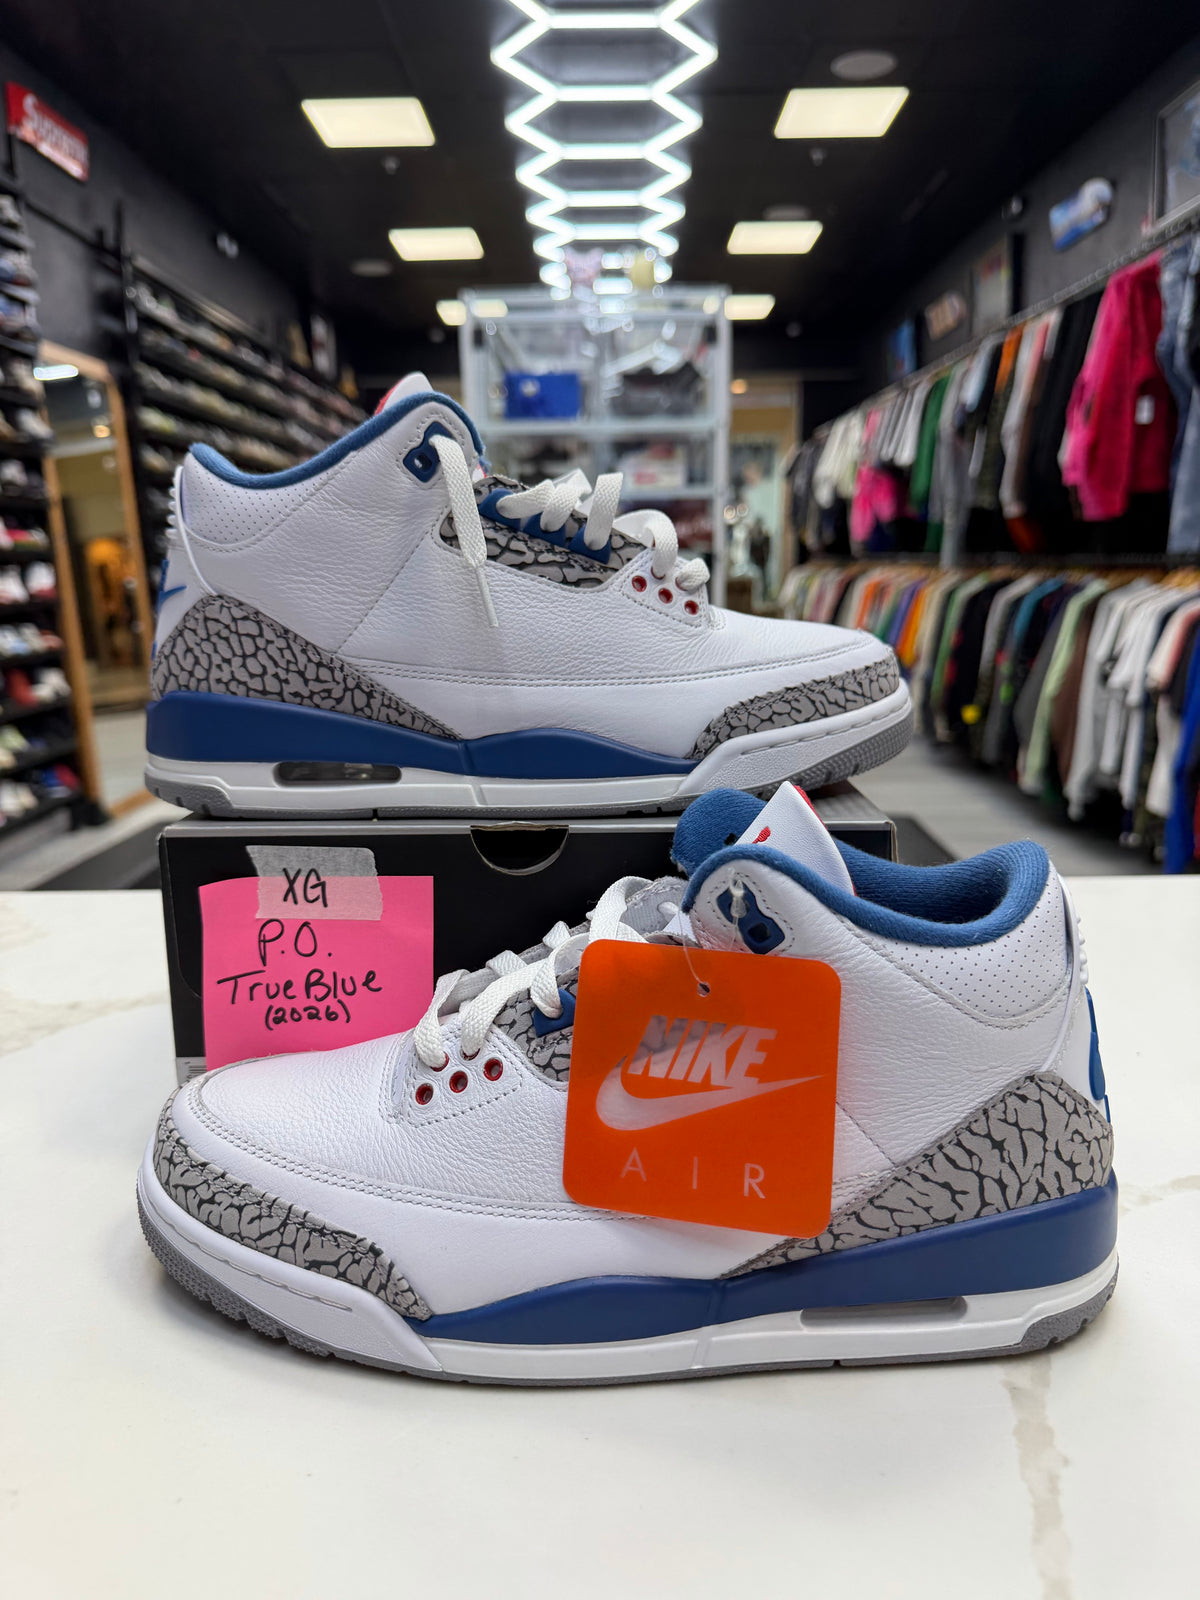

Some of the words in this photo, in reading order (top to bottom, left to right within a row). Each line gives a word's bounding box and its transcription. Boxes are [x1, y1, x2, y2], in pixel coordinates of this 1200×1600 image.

[282, 867, 328, 908] XG
[258, 918, 333, 967] P.O.
[264, 998, 351, 1031] (2026)
[627, 1014, 778, 1088] NIKE
[620, 1146, 767, 1199] AIR
